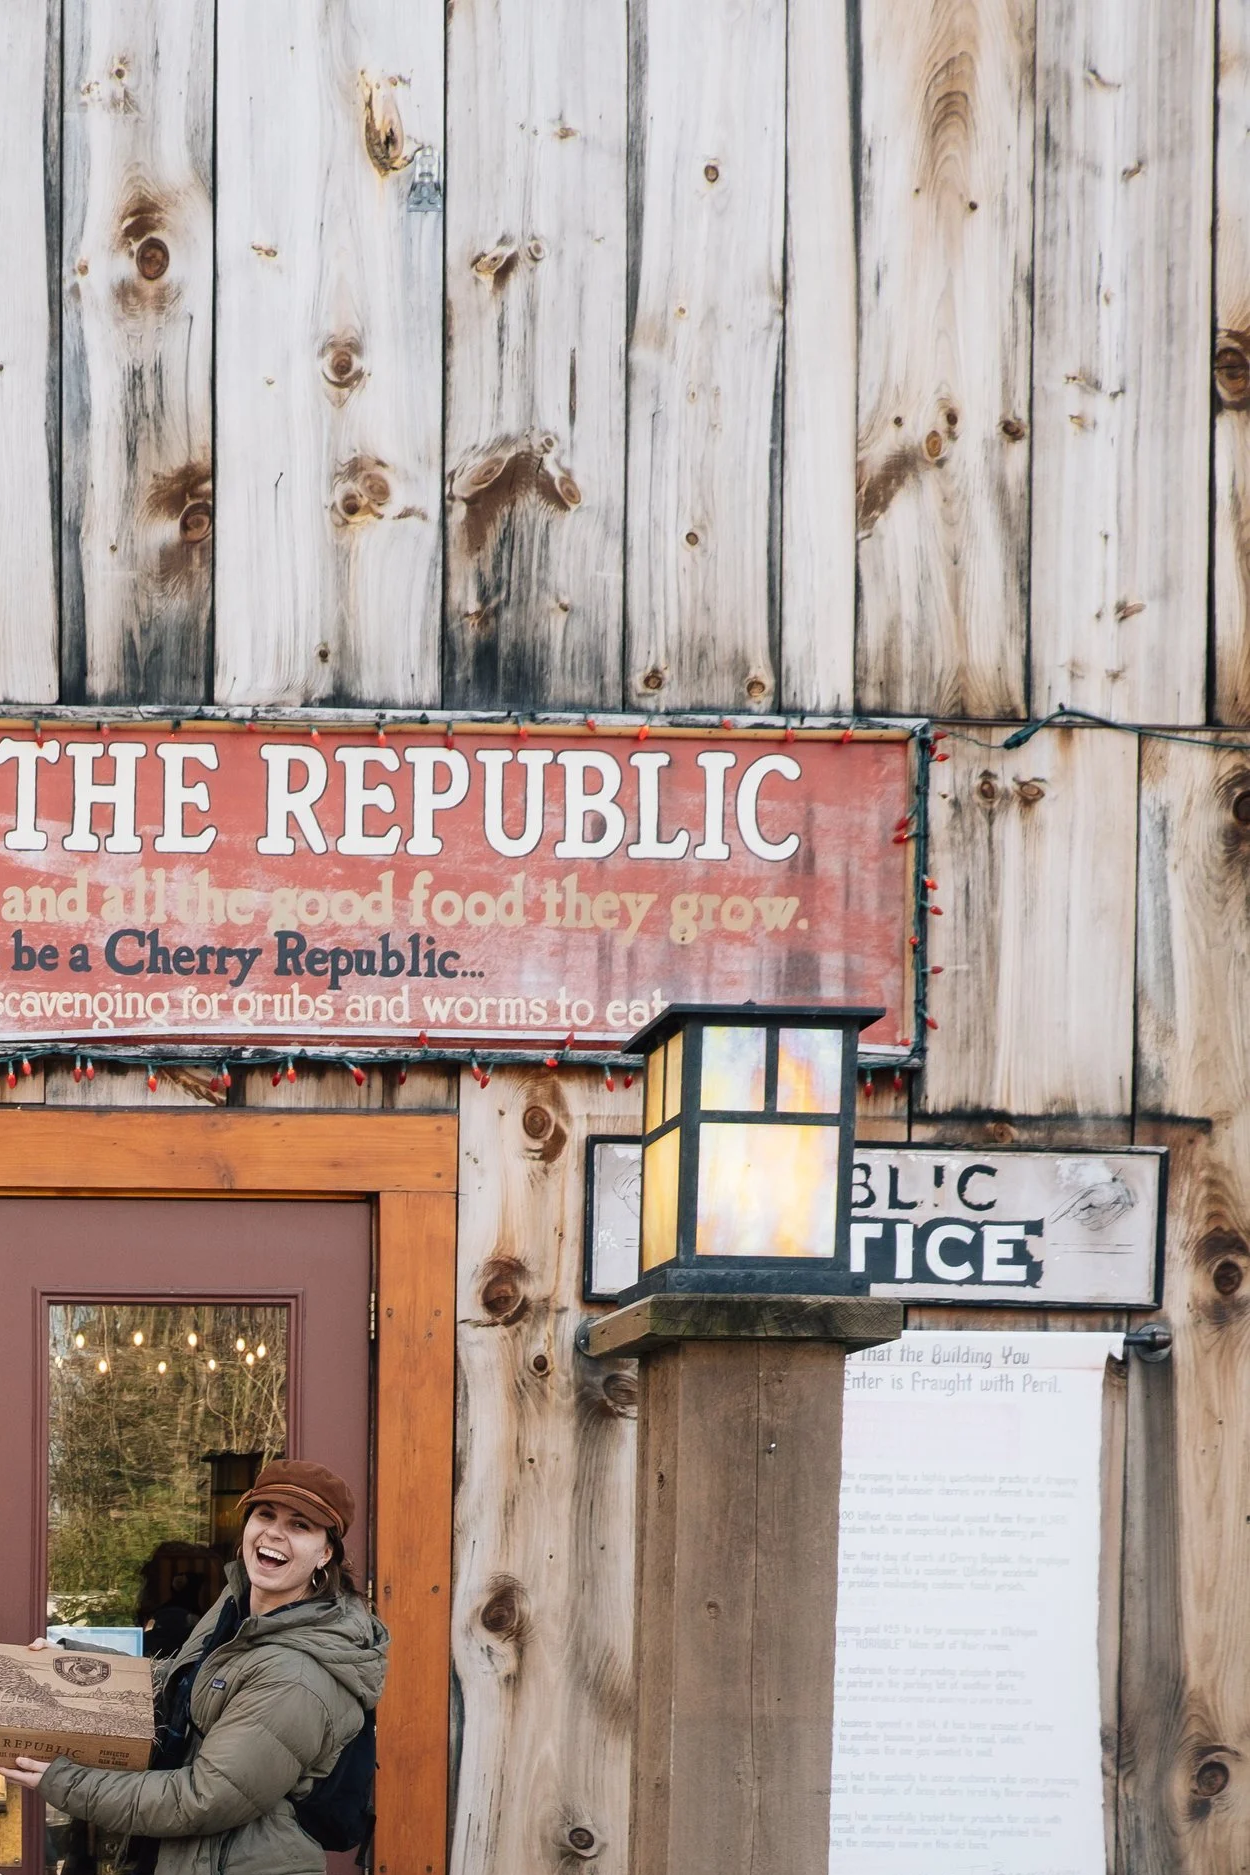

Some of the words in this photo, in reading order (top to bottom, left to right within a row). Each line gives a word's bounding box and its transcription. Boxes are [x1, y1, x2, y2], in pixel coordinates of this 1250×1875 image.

[256, 741, 802, 862] REPUBLIC
[1, 869, 90, 923] and
[101, 866, 169, 925] all
[175, 867, 255, 926] the
[268, 871, 397, 934] good
[409, 871, 527, 927] food
[543, 873, 652, 944] they
[670, 892, 810, 944] grow.
[11, 929, 59, 973] be
[69, 942, 93, 972] a
[103, 928, 262, 988] Cherry
[272, 930, 485, 991] Republic...
[182, 986, 222, 1022] for
[232, 983, 335, 1027] grubs
[344, 986, 412, 1024] and
[422, 990, 549, 1027] worms
[555, 986, 595, 1026] to
[605, 987, 669, 1027] eat
[851, 1162, 998, 1211] BLIC
[850, 1222, 1028, 1282] TICE
[900, 1344, 924, 1363] the
[932, 1344, 992, 1369] Building
[1002, 1346, 1030, 1365] You
[891, 1374, 904, 1390] is
[911, 1372, 972, 1396] Fraught
[980, 1374, 1014, 1392] with
[1022, 1374, 1061, 1393] Peril.
[3, 1738, 82, 1759] REPUBLIC
